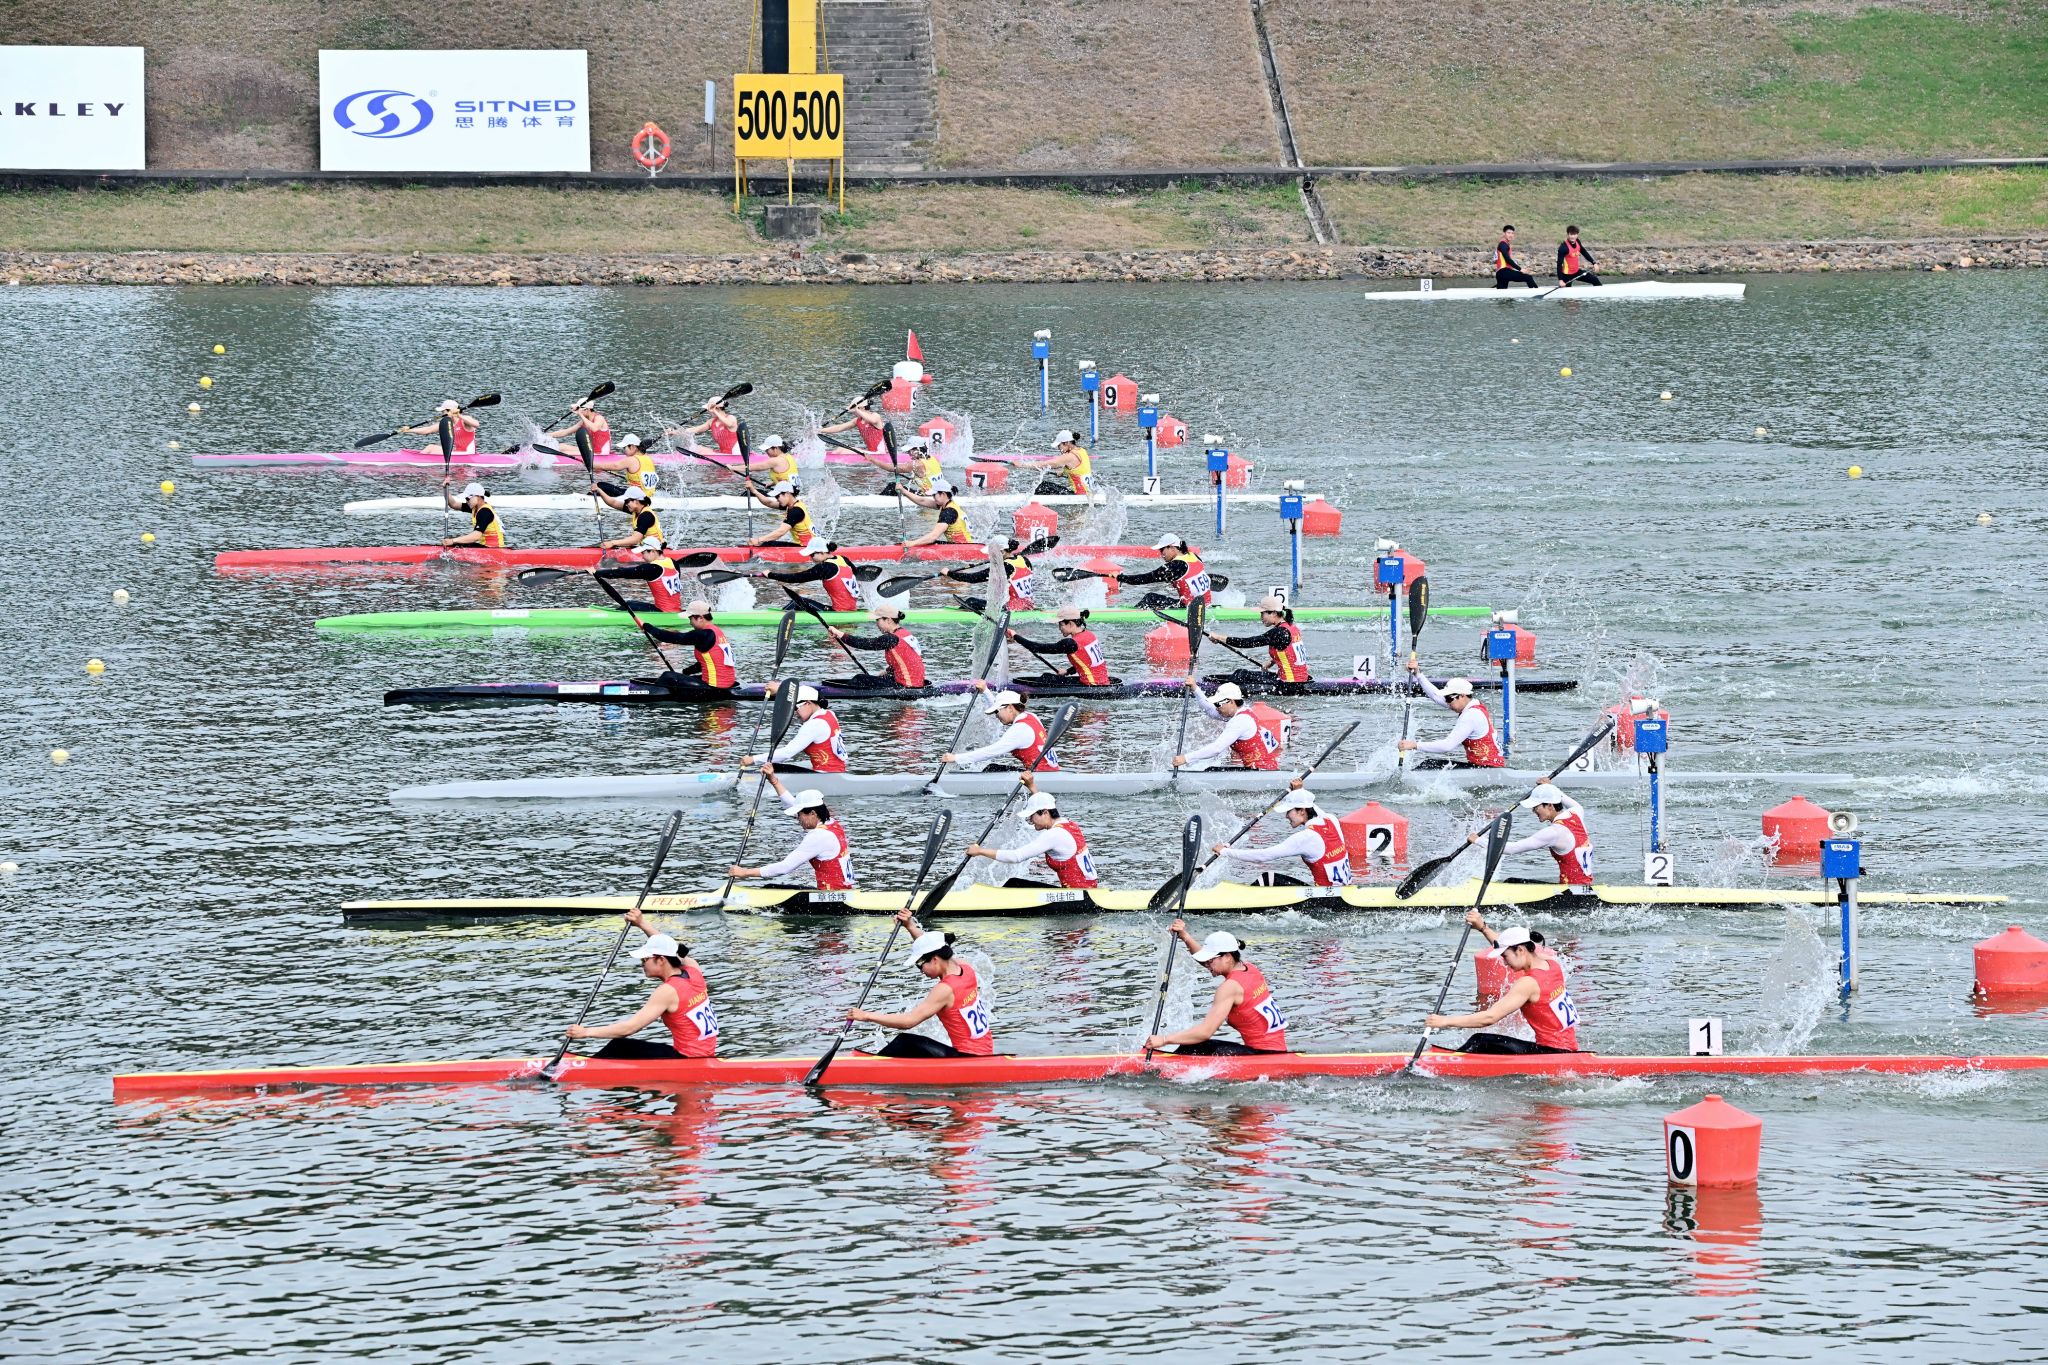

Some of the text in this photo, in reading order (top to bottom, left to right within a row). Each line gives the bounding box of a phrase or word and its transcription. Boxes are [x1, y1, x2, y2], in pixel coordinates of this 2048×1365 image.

[0, 102, 125, 116] KLEY
[454, 100, 576, 112] SITNED
[737, 90, 841, 140] 500 500
[455, 116, 576, 129] 思腾体育
[1105, 386, 1117, 406] 9
[973, 474, 986, 489] 7
[1147, 478, 1157, 492] 7
[1273, 588, 1285, 604] 5
[1357, 657, 1371, 676] 4
[1575, 750, 1590, 769] 3
[1368, 828, 1391, 856] 2
[1651, 856, 1668, 880] 2
[968, 1000, 988, 1034] 26
[1699, 1021, 1711, 1049] 1
[527, 1060, 586, 1068] NO
[1670, 1129, 1693, 1180] 0
